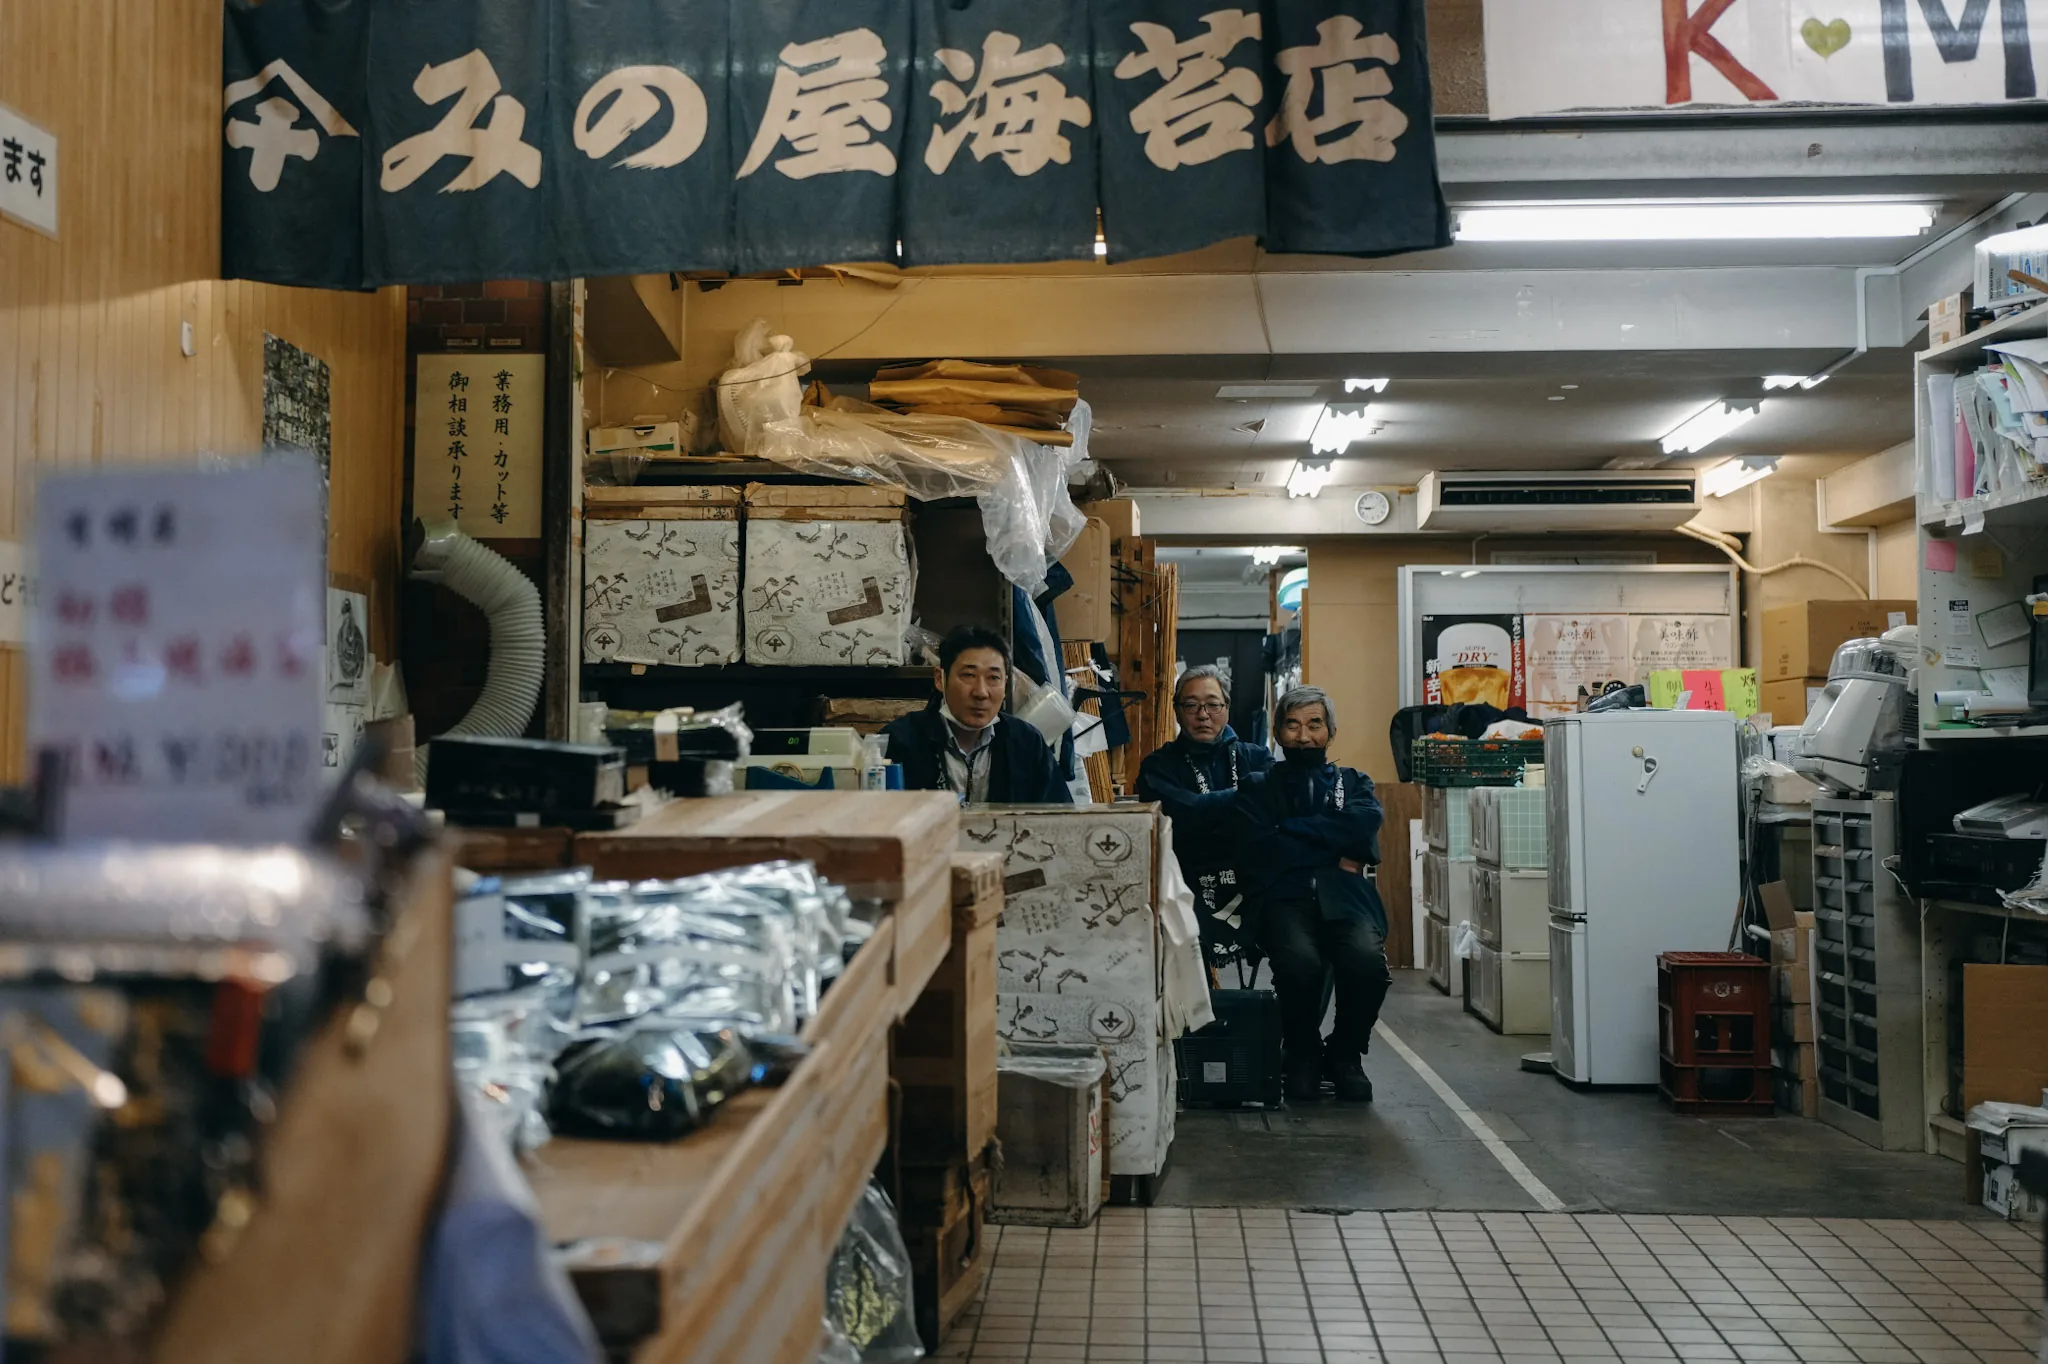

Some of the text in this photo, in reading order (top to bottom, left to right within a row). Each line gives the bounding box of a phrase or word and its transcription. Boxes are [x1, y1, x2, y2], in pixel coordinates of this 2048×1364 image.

[3, 136, 47, 199] ます
[447, 371, 470, 520] 御相談承ります
